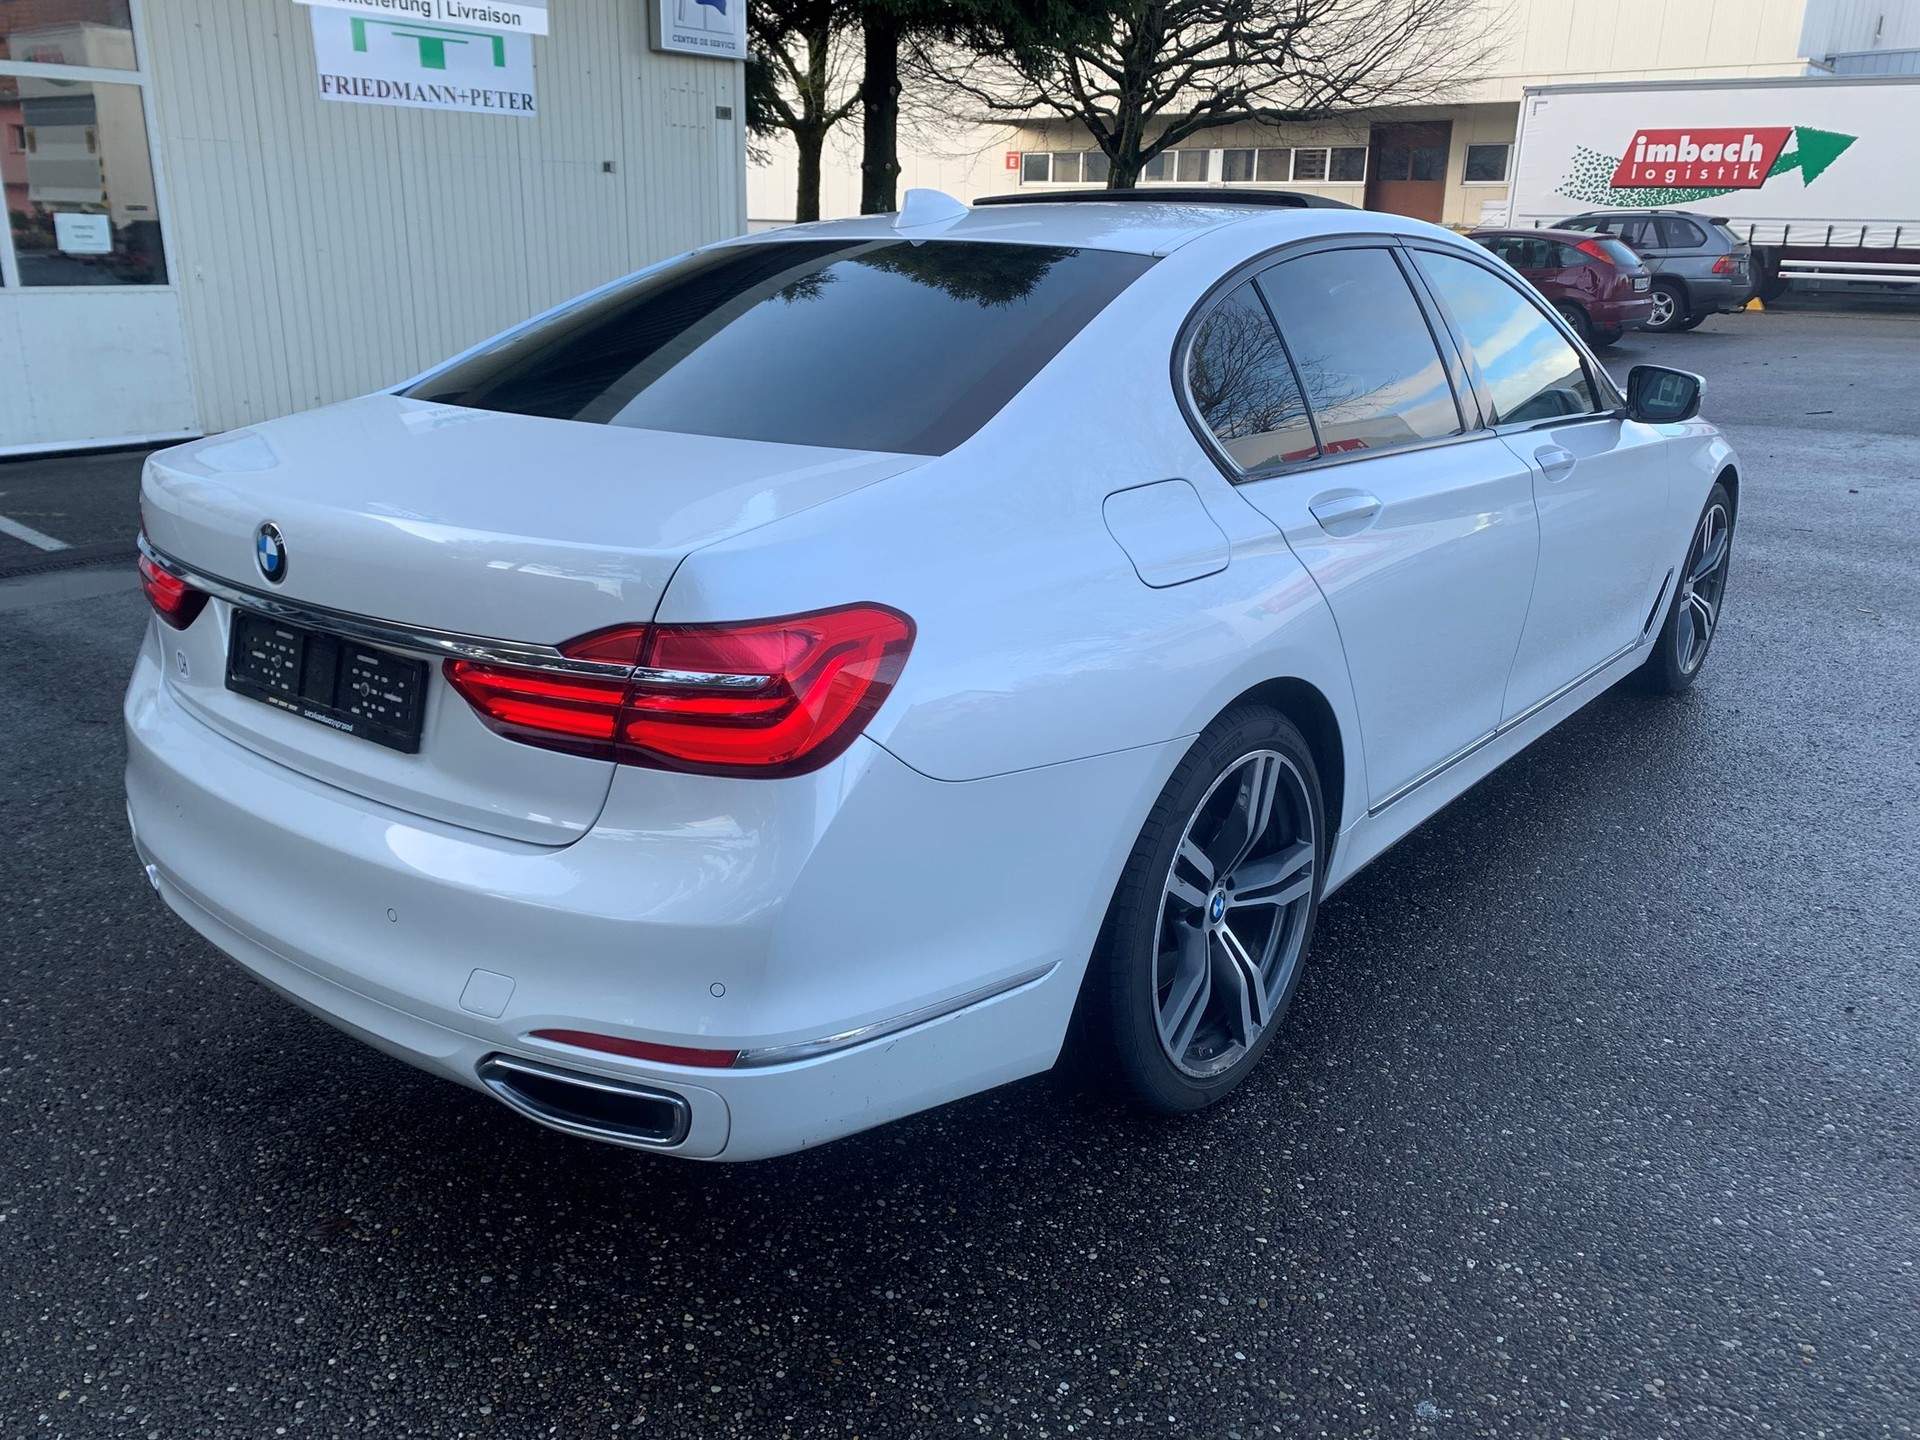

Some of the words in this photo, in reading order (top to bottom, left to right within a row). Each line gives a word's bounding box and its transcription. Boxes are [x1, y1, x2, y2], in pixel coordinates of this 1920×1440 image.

[446, 2, 522, 26] Livraison
[672, 34, 698, 45] CENTRE
[710, 40, 736, 50] SERVICE
[320, 74, 535, 111] FRIEDMANN+PETER
[1633, 134, 1763, 163] imbach
[1631, 163, 1760, 183] logistik
